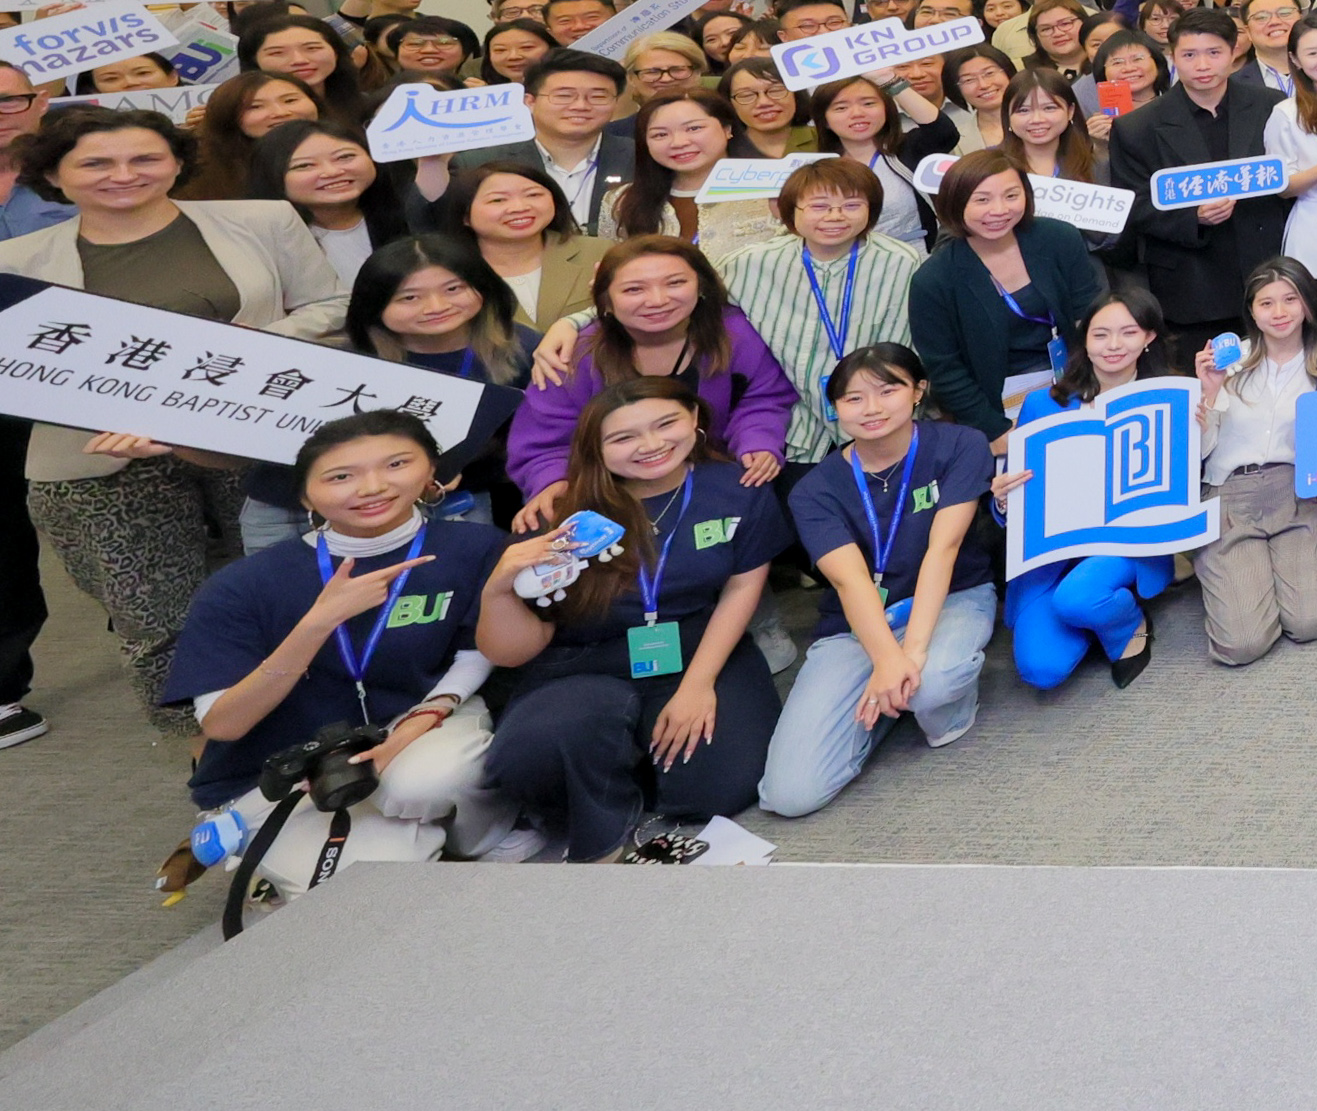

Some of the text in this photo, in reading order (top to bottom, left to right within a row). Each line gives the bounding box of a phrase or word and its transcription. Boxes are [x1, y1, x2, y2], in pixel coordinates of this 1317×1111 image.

[14, 12, 145, 56] forvis
[598, 7, 670, 57] Communication
[846, 27, 896, 50] KN
[852, 24, 973, 66] GROUP
[1074, 215, 1120, 228] Demand
[0, 357, 75, 386] HONG
[78, 374, 158, 402] KONG
[161, 389, 274, 425] BAPTIST
[27, 321, 444, 425] 香港浸會大學
[386, 590, 455, 629] BUi
